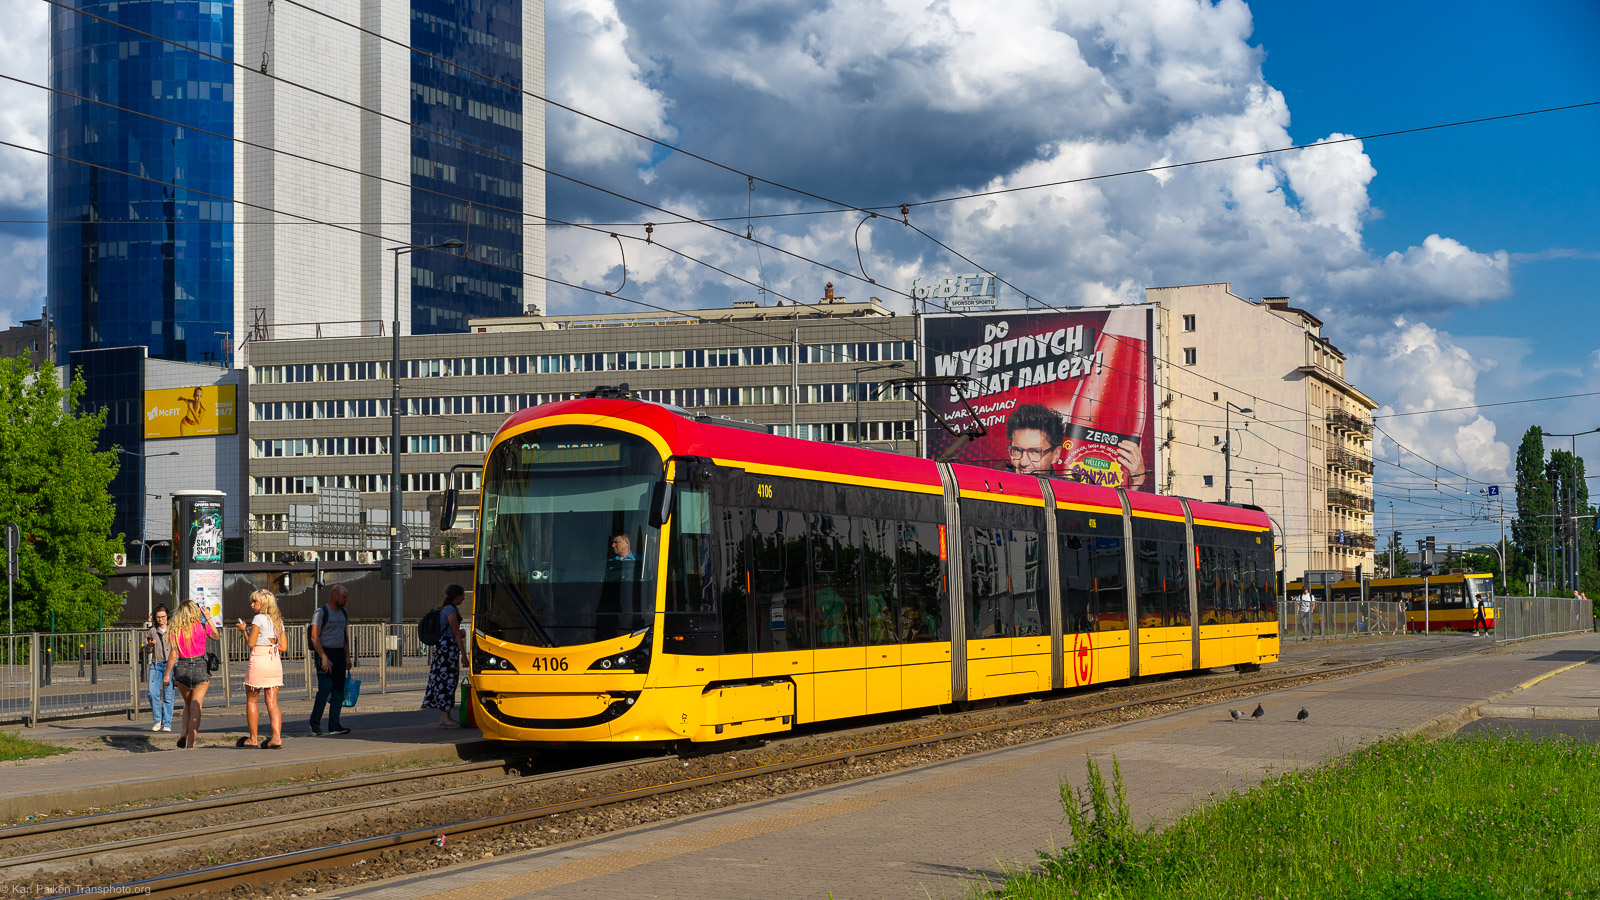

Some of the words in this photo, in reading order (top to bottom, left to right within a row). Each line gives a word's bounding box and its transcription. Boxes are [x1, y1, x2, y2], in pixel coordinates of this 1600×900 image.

[905, 272, 997, 299] forBET
[984, 320, 1009, 343] DO
[159, 408, 180, 417] McFIT
[215, 408, 233, 416] 24/7
[944, 398, 1017, 421] WARZAWIACY
[1086, 430, 1119, 445] ZERO
[1085, 458, 1109, 469] HELLENA
[757, 483, 773, 499] 4106
[196, 539, 210, 547] SAM
[532, 657, 569, 671] 4106
